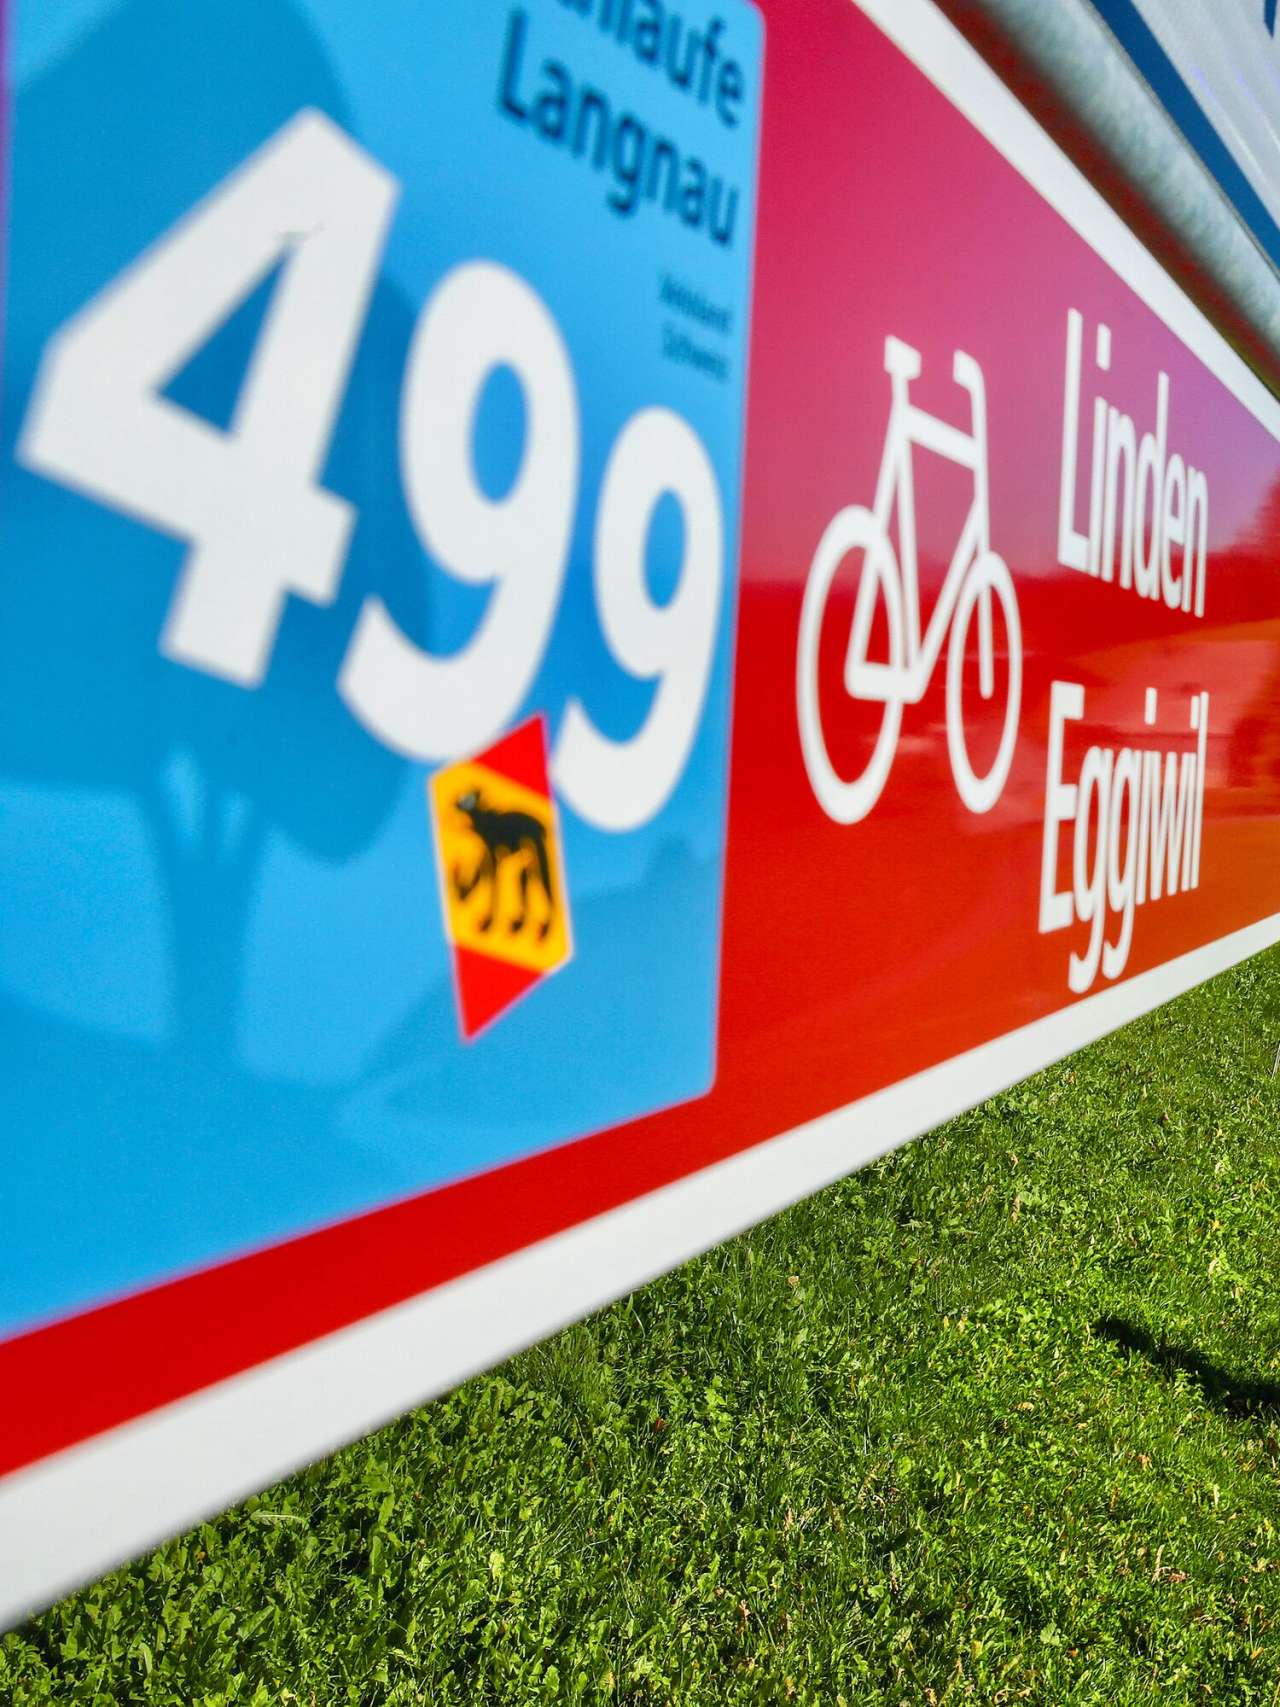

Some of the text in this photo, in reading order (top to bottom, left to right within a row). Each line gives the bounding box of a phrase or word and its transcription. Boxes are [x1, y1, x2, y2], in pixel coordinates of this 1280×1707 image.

[497, 8, 740, 247] Langnau
[16, 106, 723, 833] 499
[1057, 307, 1209, 619] Linden
[1038, 679, 1209, 994] Eggiwil
